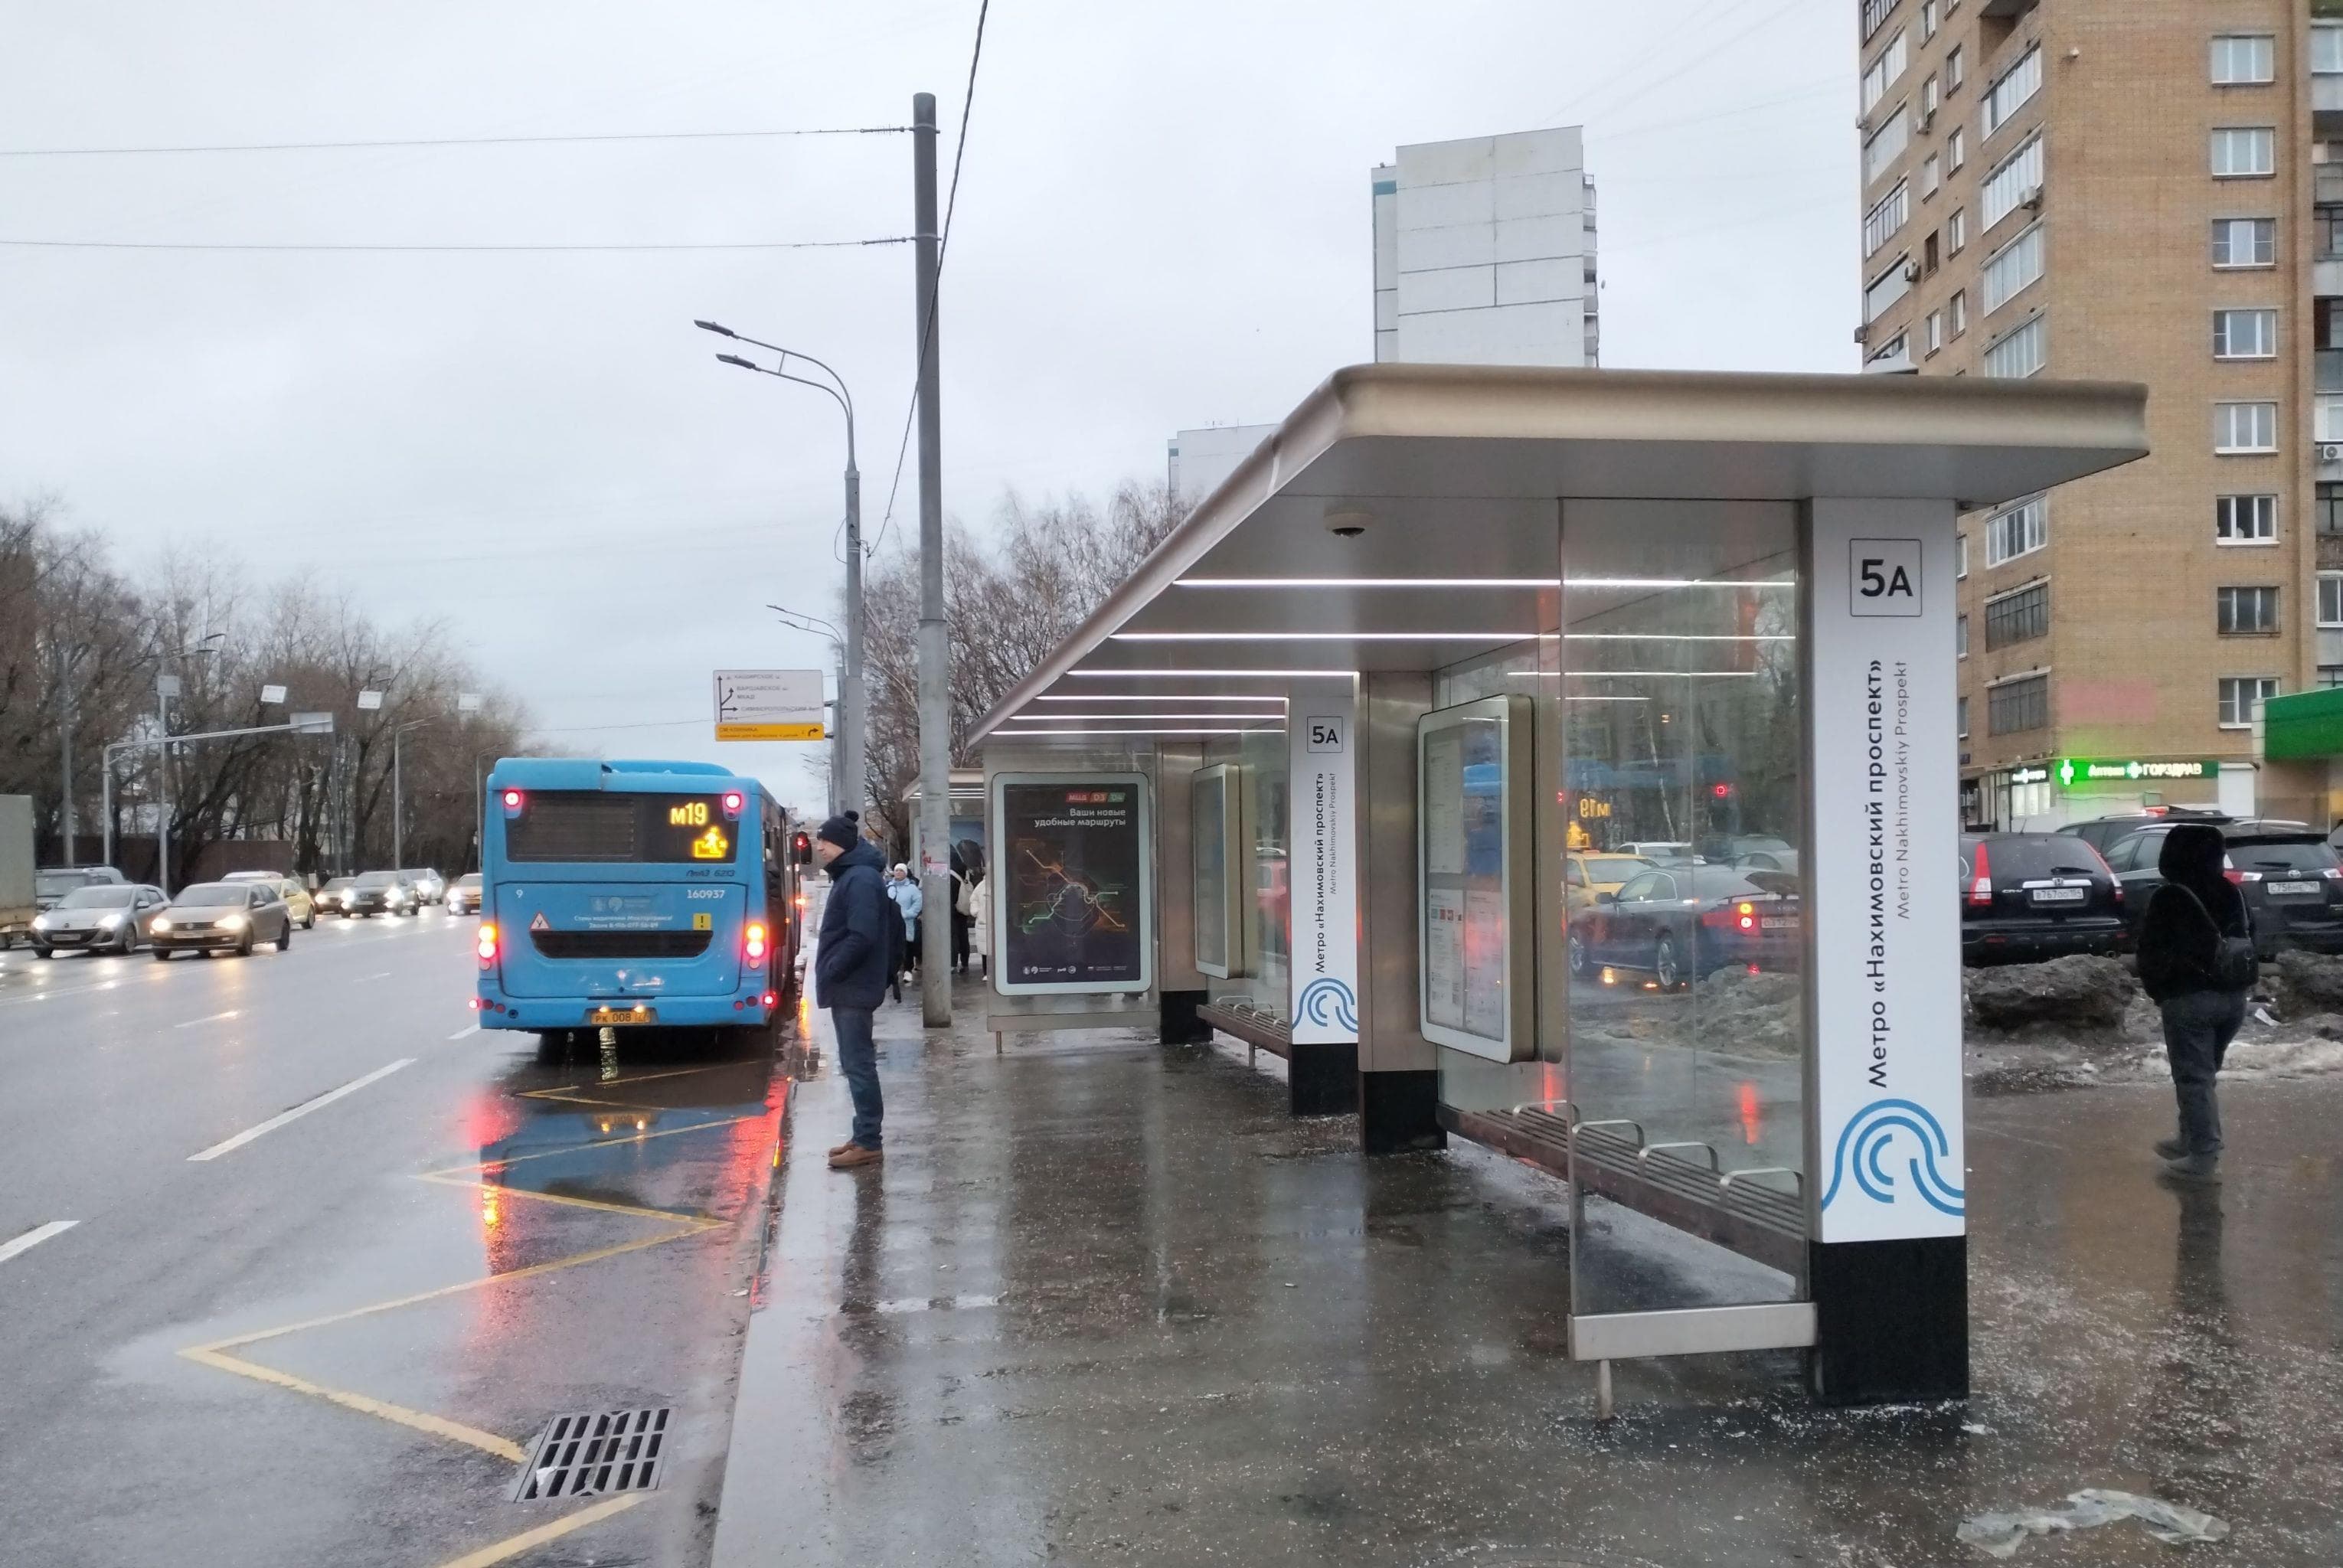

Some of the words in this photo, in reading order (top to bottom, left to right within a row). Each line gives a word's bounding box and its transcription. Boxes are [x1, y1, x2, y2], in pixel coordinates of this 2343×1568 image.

[1868, 660, 1887, 792] проспект»
[1894, 661, 1910, 736] Prospekt
[1328, 773, 1338, 808] Prospekt
[2142, 763, 2202, 778] ГОРЗДРАВ
[1034, 818, 1075, 827] удобные
[1077, 819, 1126, 828] маршруты
[1315, 773, 1326, 835] проспект»
[1895, 740, 1911, 861] Nakhimovskiy
[1329, 810, 1338, 867] Nakhimovskiy
[516, 890, 524, 899] 9
[686, 889, 726, 900] 160937
[1315, 839, 1325, 929] «Нахимовский
[1865, 802, 1886, 993] «Нахимовский
[1897, 867, 1910, 920] Metro
[1315, 932, 1326, 974] Метро
[1868, 1001, 1890, 1089] Метро
